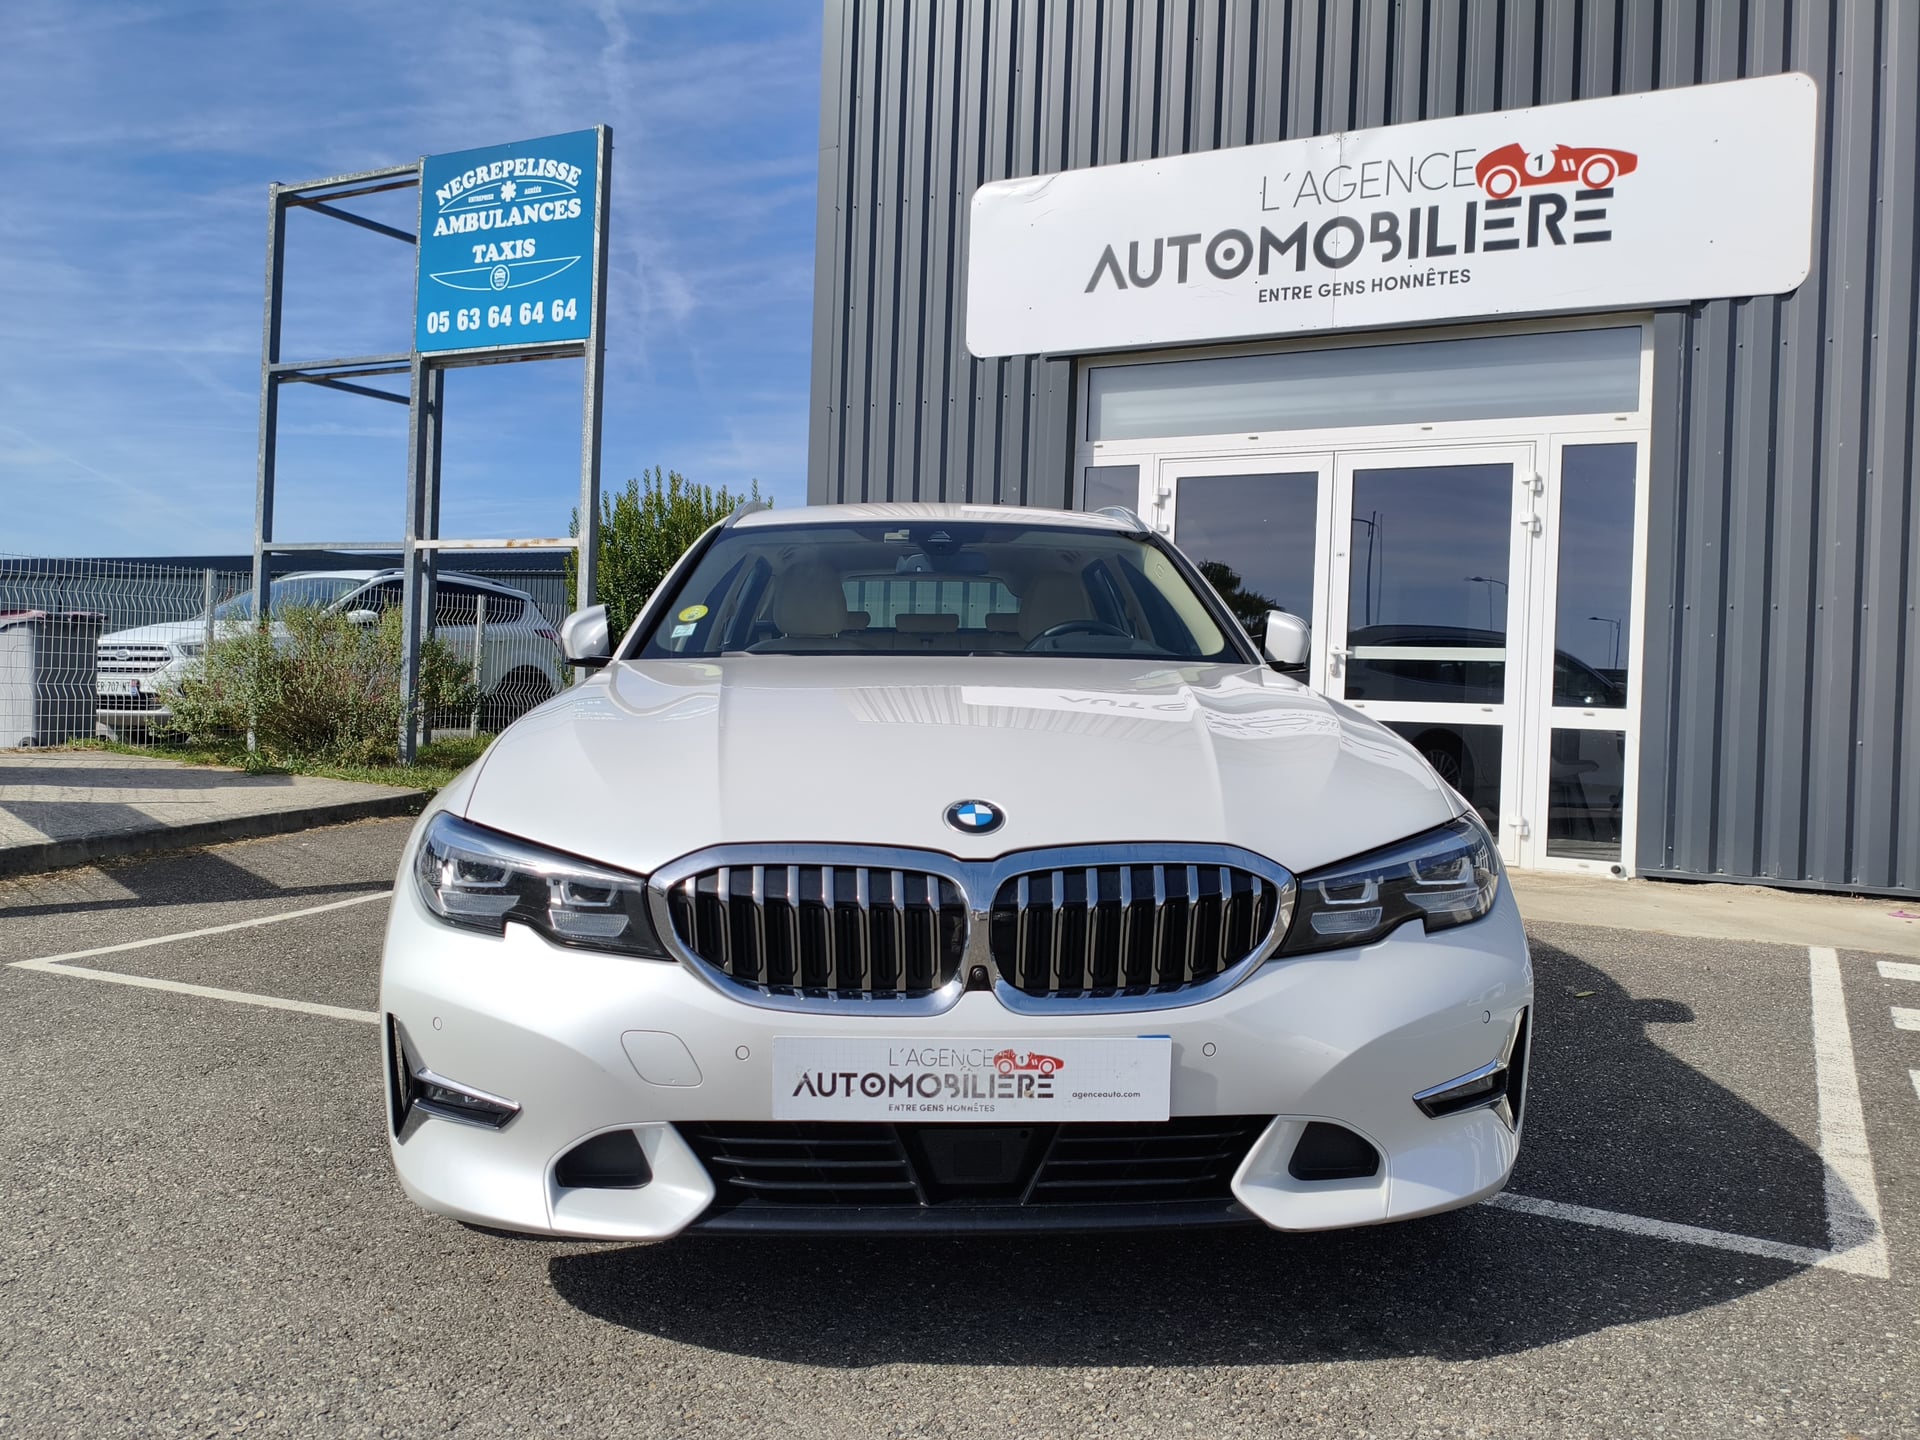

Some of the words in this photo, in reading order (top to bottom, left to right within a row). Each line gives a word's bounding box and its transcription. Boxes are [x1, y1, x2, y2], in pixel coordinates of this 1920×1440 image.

[1261, 149, 1477, 211] L'AGENCE
[1534, 154, 1544, 171] 1
[436, 158, 582, 206] NEGREPELISSE
[433, 198, 582, 236] AMBULANCES
[472, 238, 536, 263] TAXIS
[1258, 285, 1313, 303] ENTRE
[1318, 280, 1366, 297] GENS
[1371, 268, 1471, 293] HONNÊTES
[427, 311, 450, 334] 05
[457, 308, 480, 331] 63
[488, 305, 512, 328] 64
[519, 301, 544, 325] 64
[552, 298, 577, 322] 64
[888, 1103, 917, 1112] ENTRE
[919, 1103, 944, 1112] GENS
[946, 1102, 995, 1112] HONNÊTES
[1072, 1091, 1141, 1099] agenceauto.com
